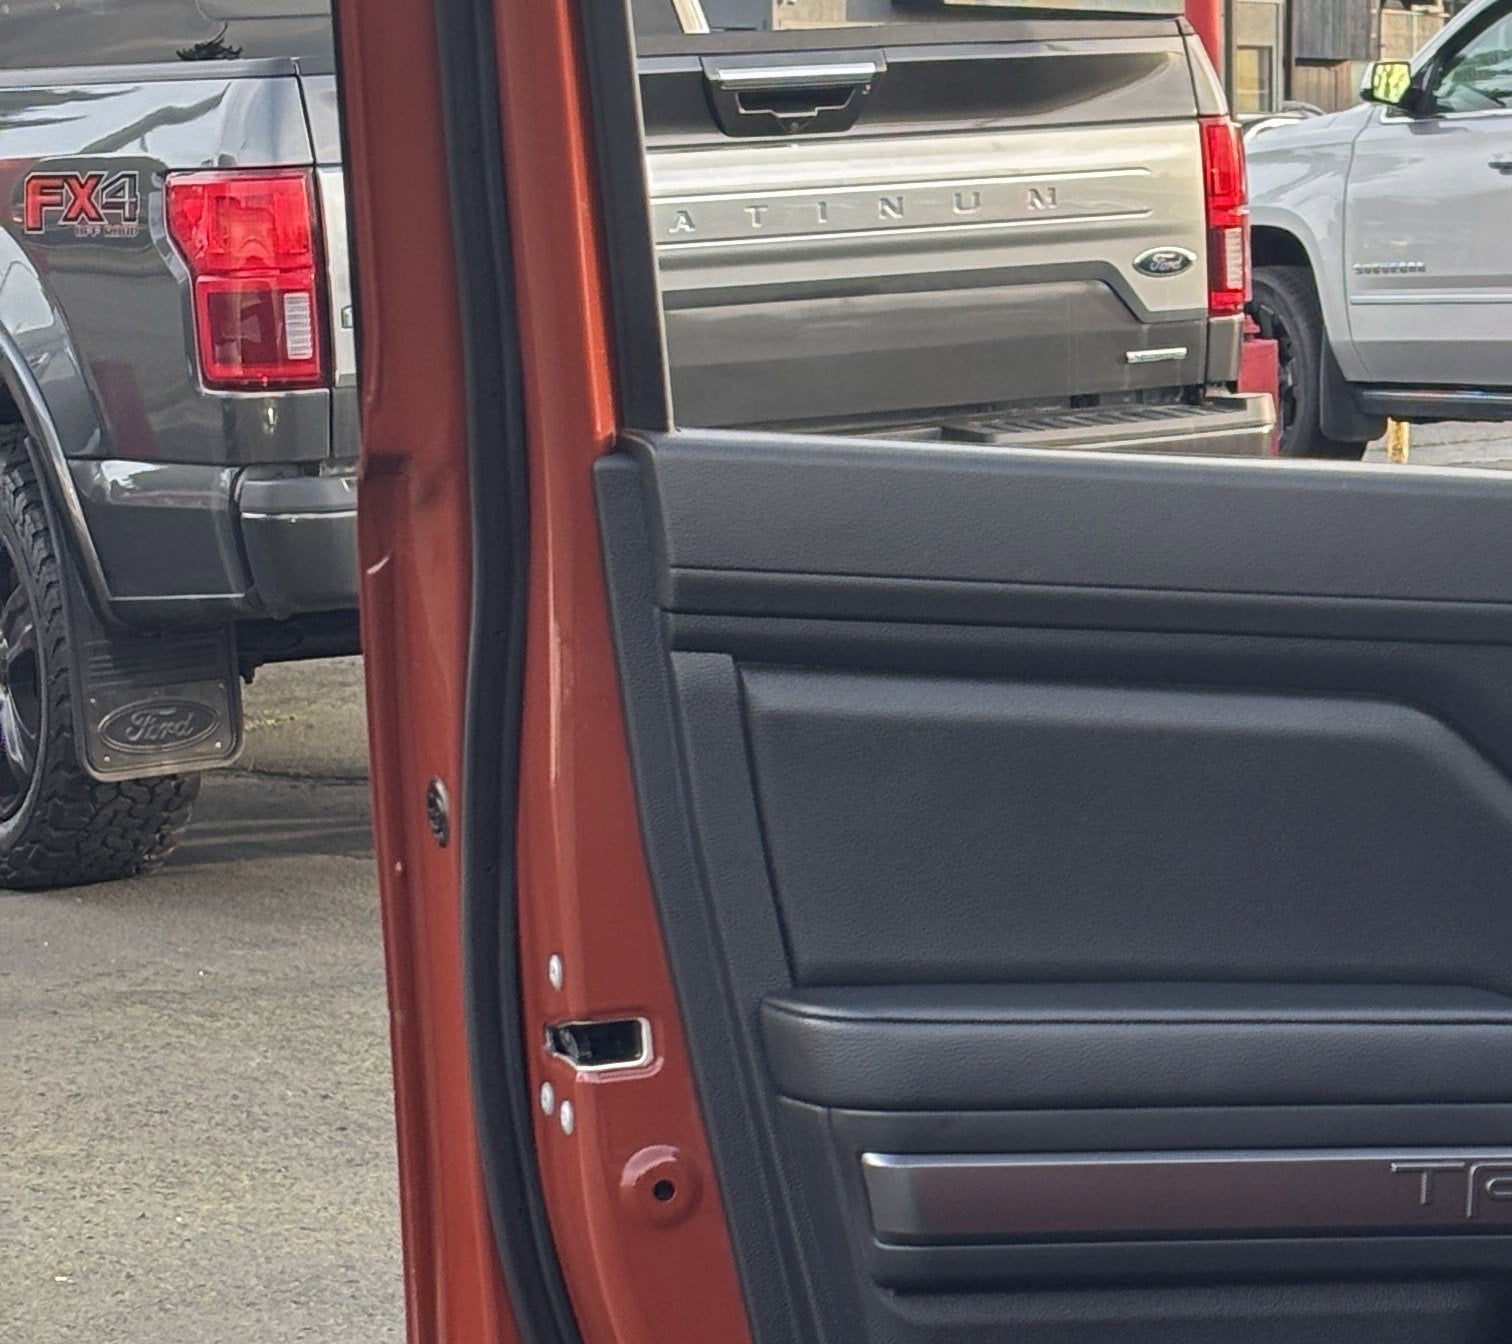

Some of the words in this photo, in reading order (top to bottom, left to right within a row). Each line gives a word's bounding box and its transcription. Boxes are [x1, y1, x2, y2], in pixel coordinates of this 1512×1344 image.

[24, 170, 141, 234] FX4
[668, 186, 1058, 234] ATINUM
[125, 706, 195, 742] Ford
